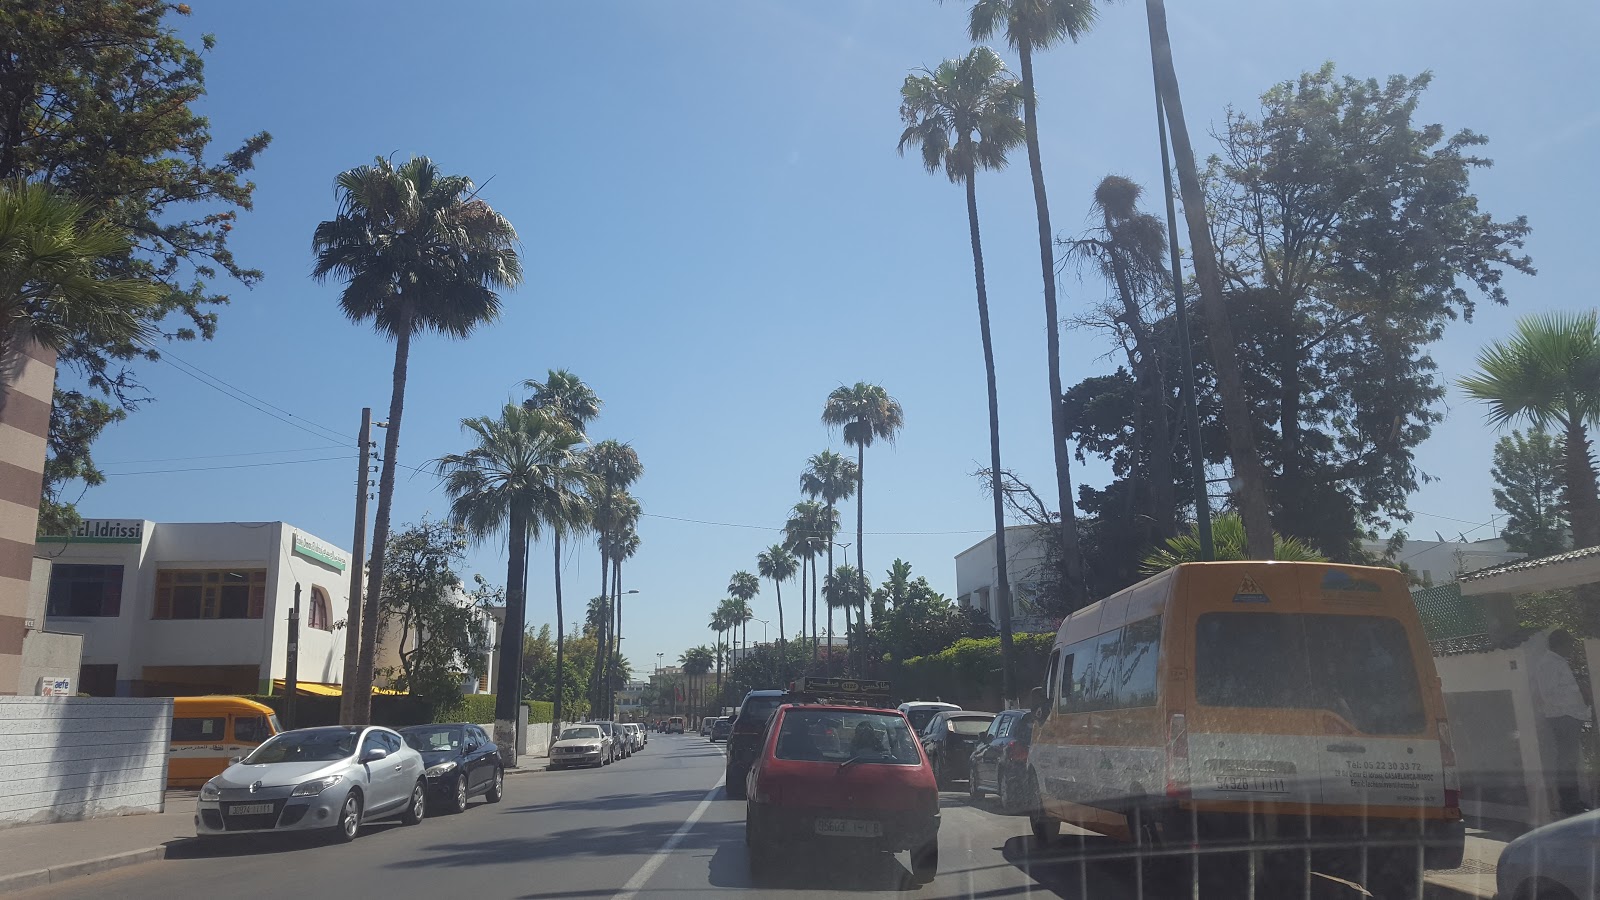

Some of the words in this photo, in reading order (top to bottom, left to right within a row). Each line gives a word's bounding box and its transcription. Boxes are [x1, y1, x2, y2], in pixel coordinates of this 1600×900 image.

[77, 521, 90, 537] El
[95, 521, 140, 538] Idrissi
[54, 679, 69, 689] aefe
[1364, 761, 1374, 769] 05
[1376, 762, 1386, 770] 22
[1388, 762, 1398, 770] 30
[1400, 762, 1410, 771] 33
[1411, 763, 1421, 771] 72
